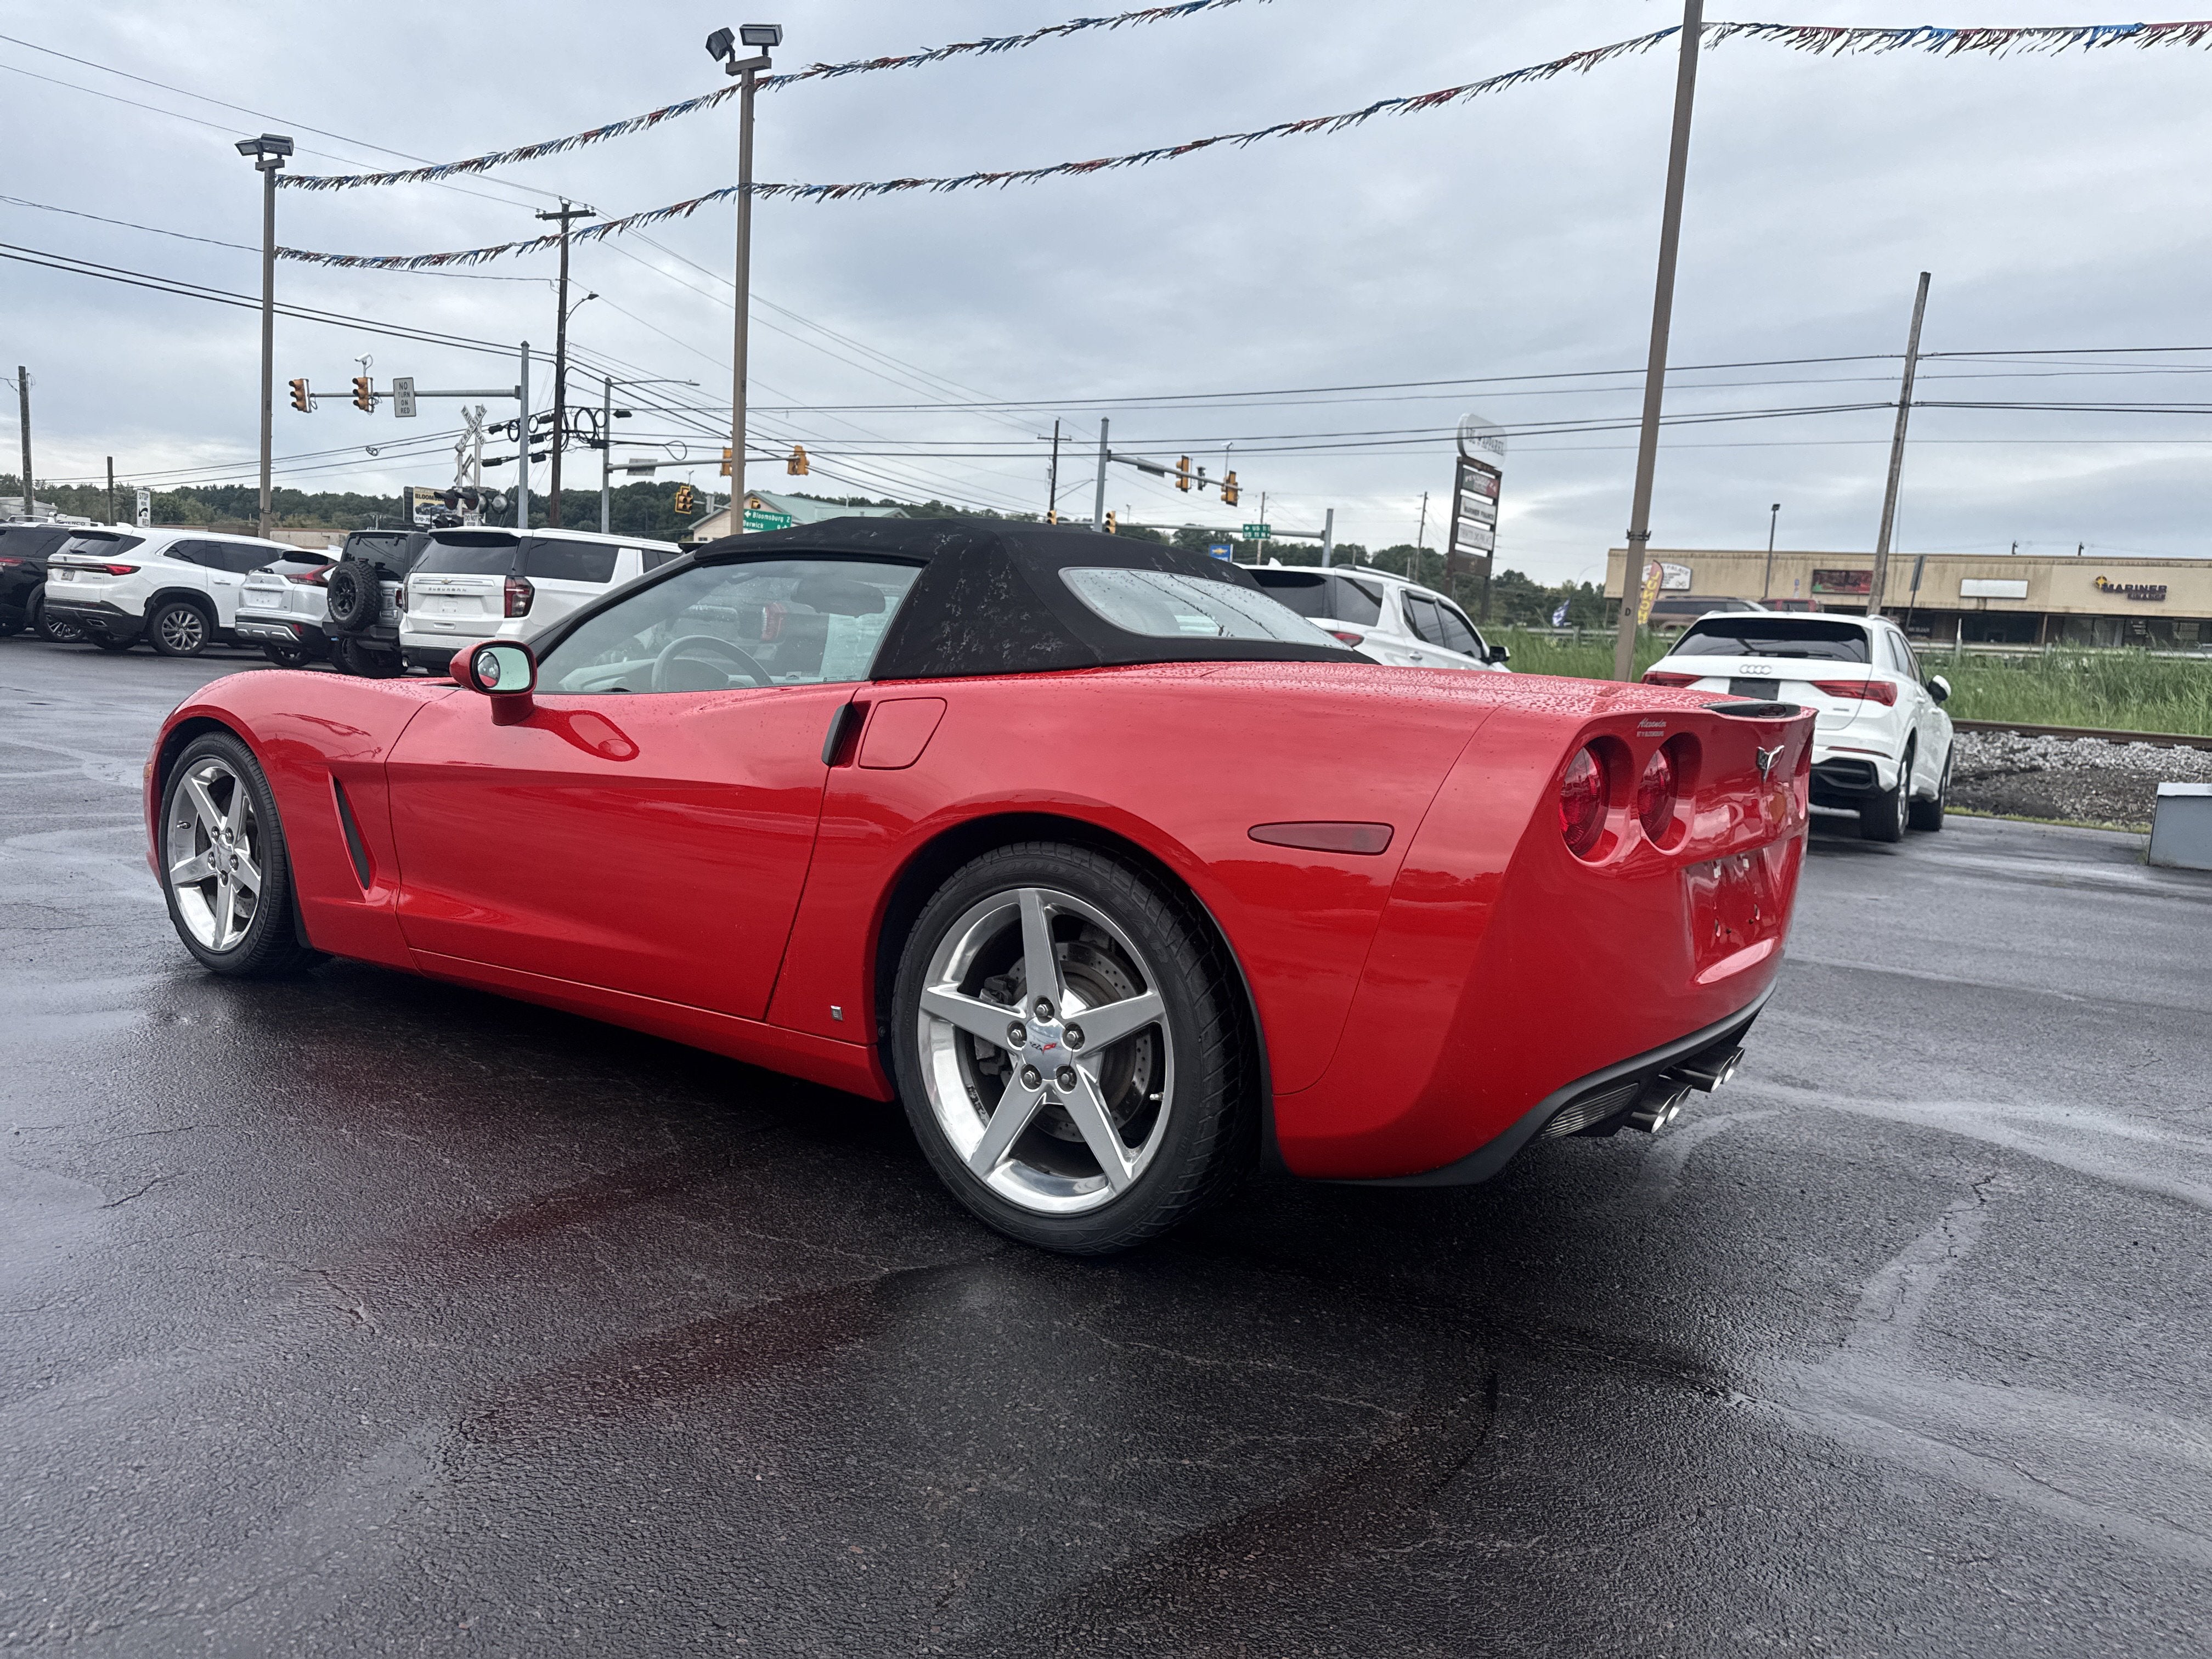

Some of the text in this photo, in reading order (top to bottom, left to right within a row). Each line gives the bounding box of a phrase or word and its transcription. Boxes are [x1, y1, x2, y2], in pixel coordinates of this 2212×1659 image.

[399, 382, 408, 390] NO
[461, 407, 485, 445] CROSSING
[752, 511, 784, 523] Bloomsburg
[743, 520, 764, 529] Berwick
[2101, 584, 2167, 593] MARINER
[1638, 571, 1660, 624] LUNCH
[1625, 607, 1631, 616] D
